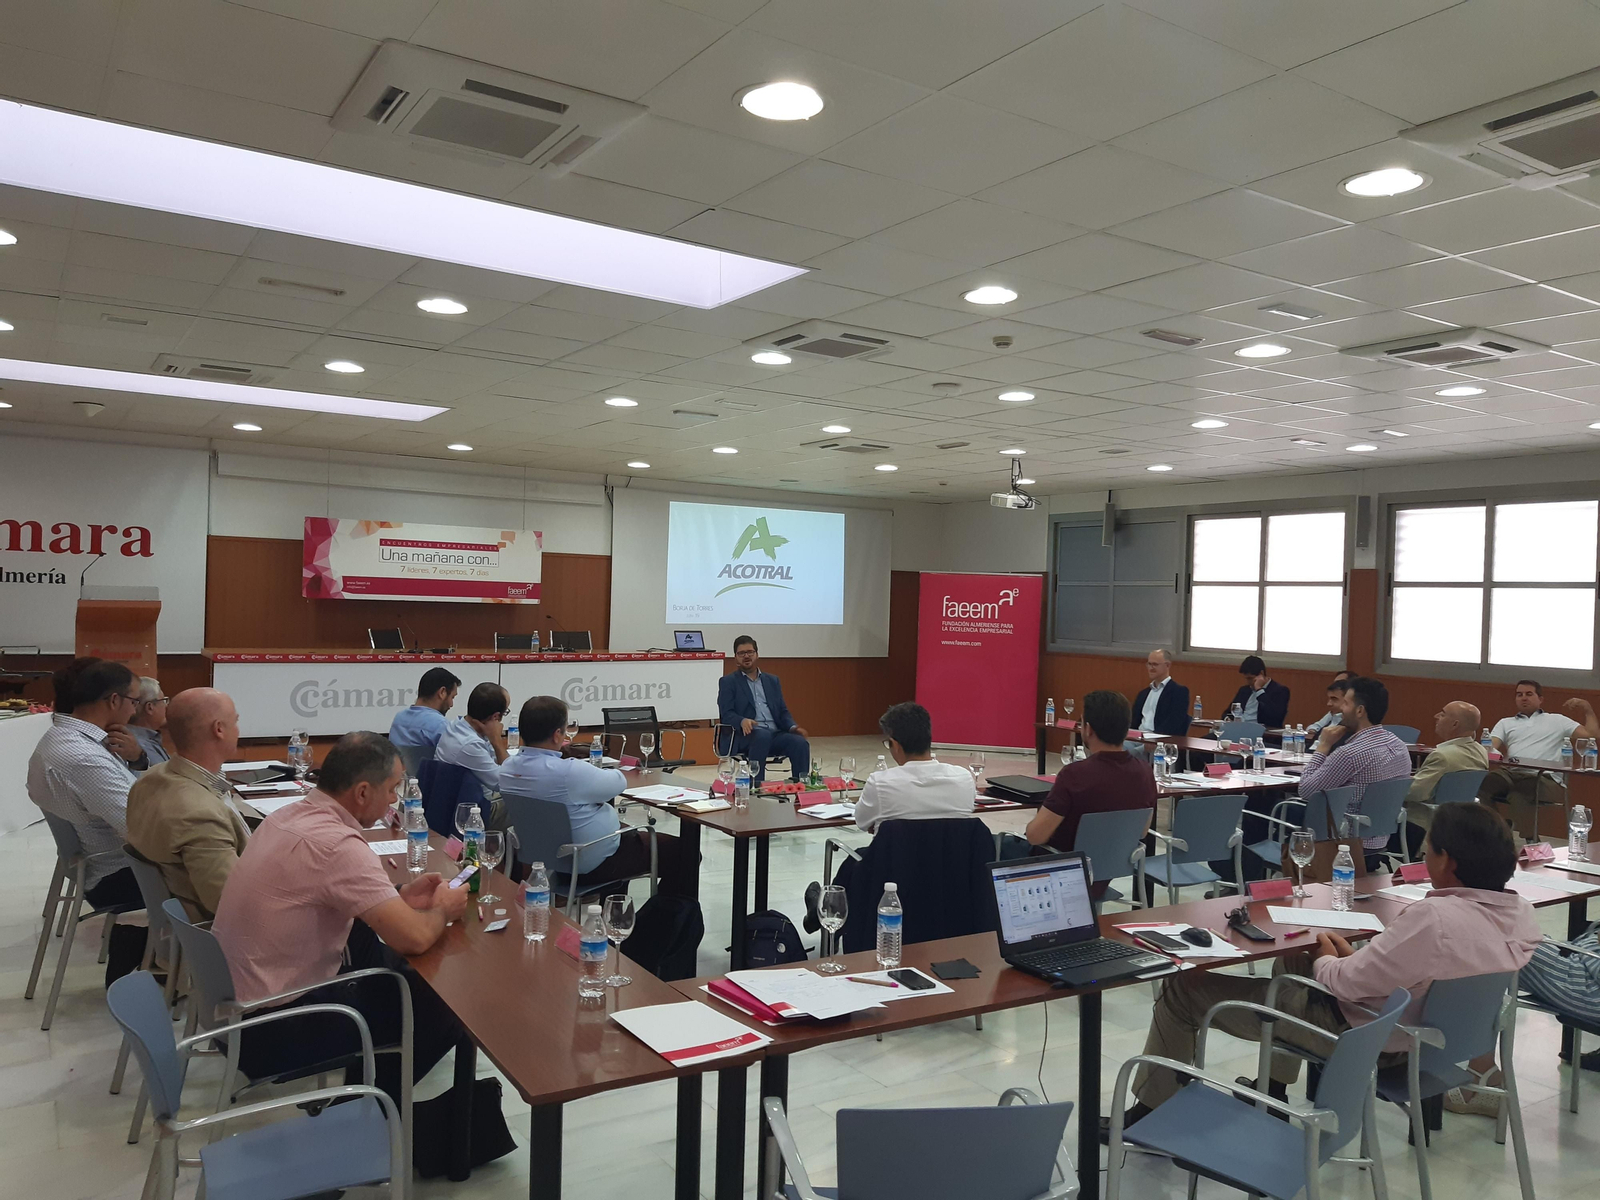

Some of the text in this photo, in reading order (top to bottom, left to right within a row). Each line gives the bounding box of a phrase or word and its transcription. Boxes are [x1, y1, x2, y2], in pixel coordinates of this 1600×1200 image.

[381, 548, 408, 561] Una
[411, 551, 464, 564] mañana
[400, 565, 406, 573] 7
[432, 566, 438, 574] 7
[469, 568, 475, 576] 7
[717, 563, 794, 580] ACOTRAL
[942, 596, 998, 618] faeem
[290, 679, 417, 718] Cámar
